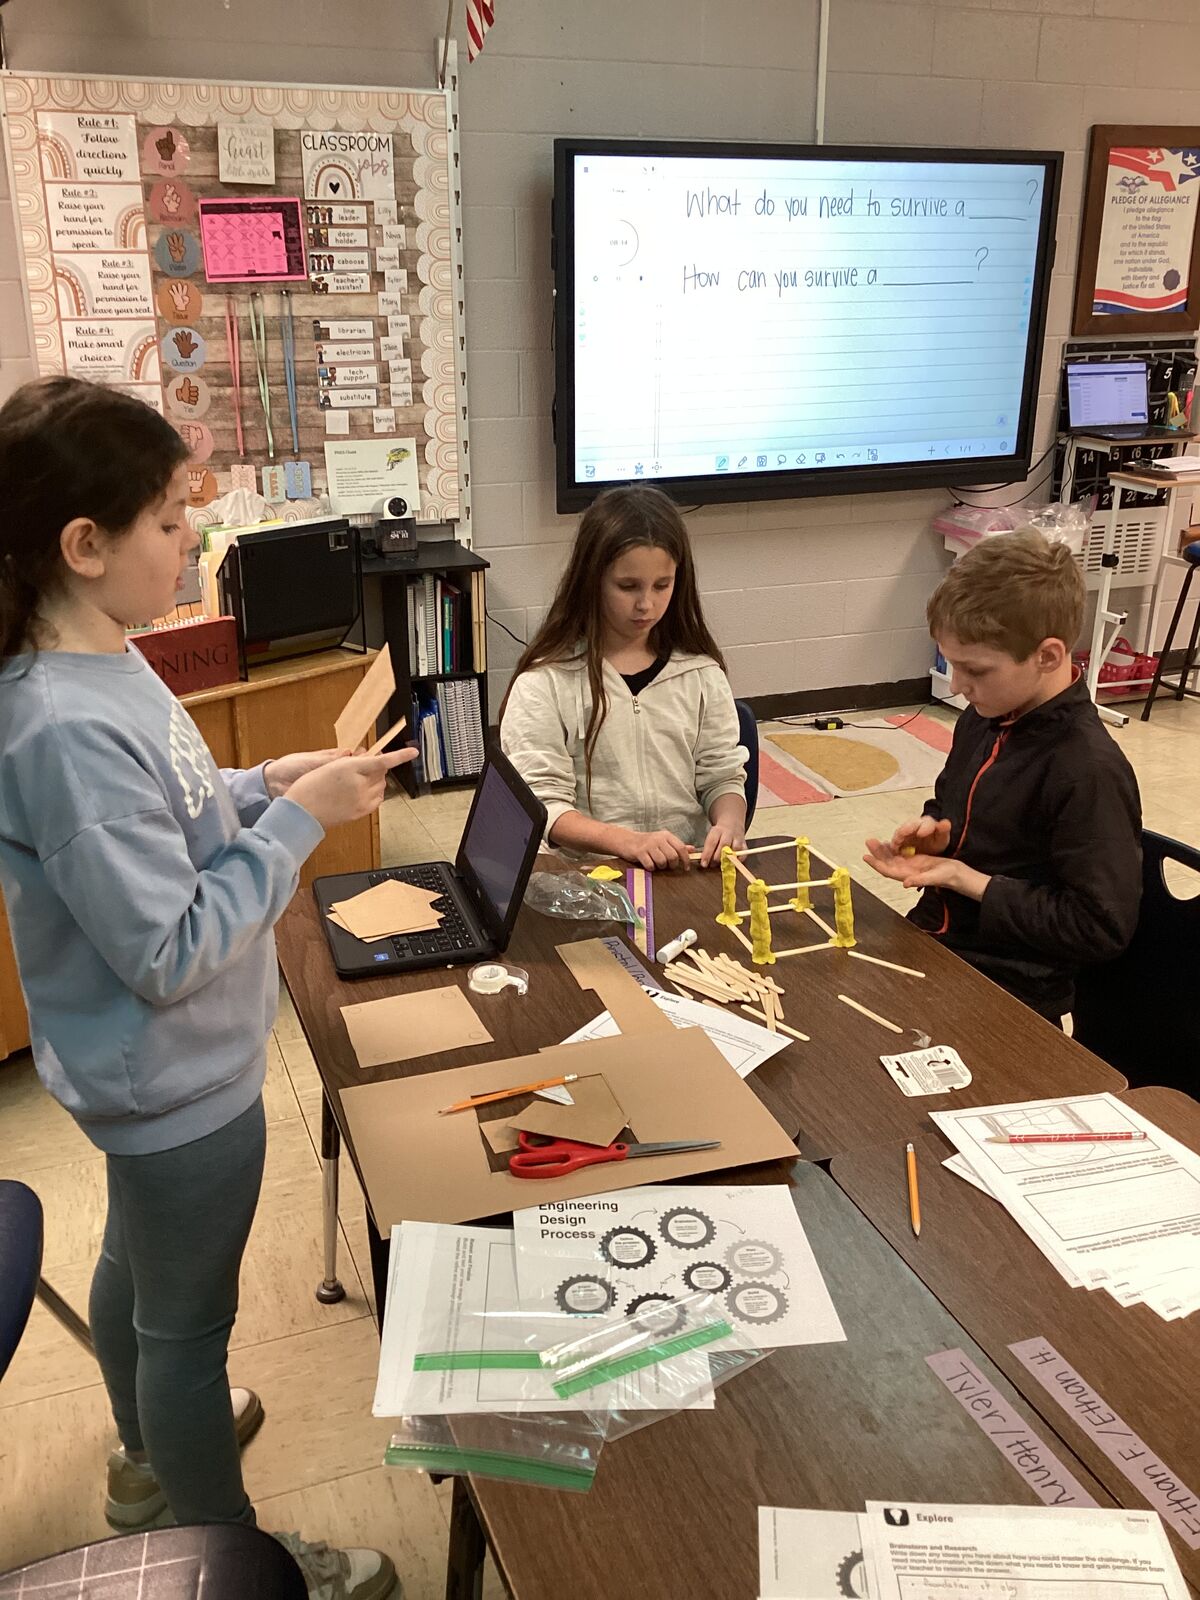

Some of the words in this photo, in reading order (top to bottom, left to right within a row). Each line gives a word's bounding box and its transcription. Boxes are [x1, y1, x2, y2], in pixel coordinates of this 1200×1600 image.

[78, 117, 100, 128] Rule
[81, 132, 119, 145] Follow
[303, 134, 390, 153] CLASSROOM
[76, 149, 127, 160] directions
[83, 165, 124, 178] quickly
[357, 152, 390, 183] jobs
[61, 188, 81, 198] Rule
[686, 189, 742, 218] What
[754, 189, 775, 216] do
[784, 202, 808, 222] you
[819, 188, 853, 218] need
[866, 189, 881, 217] to
[891, 199, 948, 217] survive
[954, 202, 966, 217] a
[1112, 196, 1136, 204] PLEDGE
[1138, 196, 1148, 204] OF
[1150, 196, 1190, 204] ALLEGIANCE
[58, 202, 81, 211] Raise
[83, 203, 106, 213] your
[63, 215, 86, 223] hand
[86, 216, 103, 225] for
[55, 228, 102, 238] permission
[104, 228, 114, 236] to
[71, 241, 100, 251] speak.
[101, 259, 120, 268] Rule
[97, 271, 119, 280] Raise
[120, 273, 141, 282] your
[683, 264, 720, 294] How
[738, 270, 766, 292] can
[774, 269, 798, 298] you
[805, 267, 859, 289] survive
[867, 270, 878, 286] a
[102, 283, 124, 291] hand
[125, 284, 139, 293] for
[95, 295, 138, 304] permission
[91, 306, 113, 315] leave
[114, 308, 133, 317] your
[133, 306, 153, 315] seat.
[75, 326, 96, 336] Rule
[68, 340, 95, 349] Make
[95, 340, 125, 349] smart
[79, 353, 116, 363] choices.
[172, 358, 197, 368] Question
[343, 374, 370, 382] support
[1163, 367, 1173, 379] 5
[1153, 407, 1166, 420] 11
[1082, 450, 1095, 464] 14
[1131, 447, 1142, 458] 16
[1150, 446, 1164, 458] 17
[539, 1201, 618, 1212] Engineering
[540, 1214, 586, 1227] Design
[541, 1229, 596, 1239] Process
[916, 1513, 954, 1523] Explore
